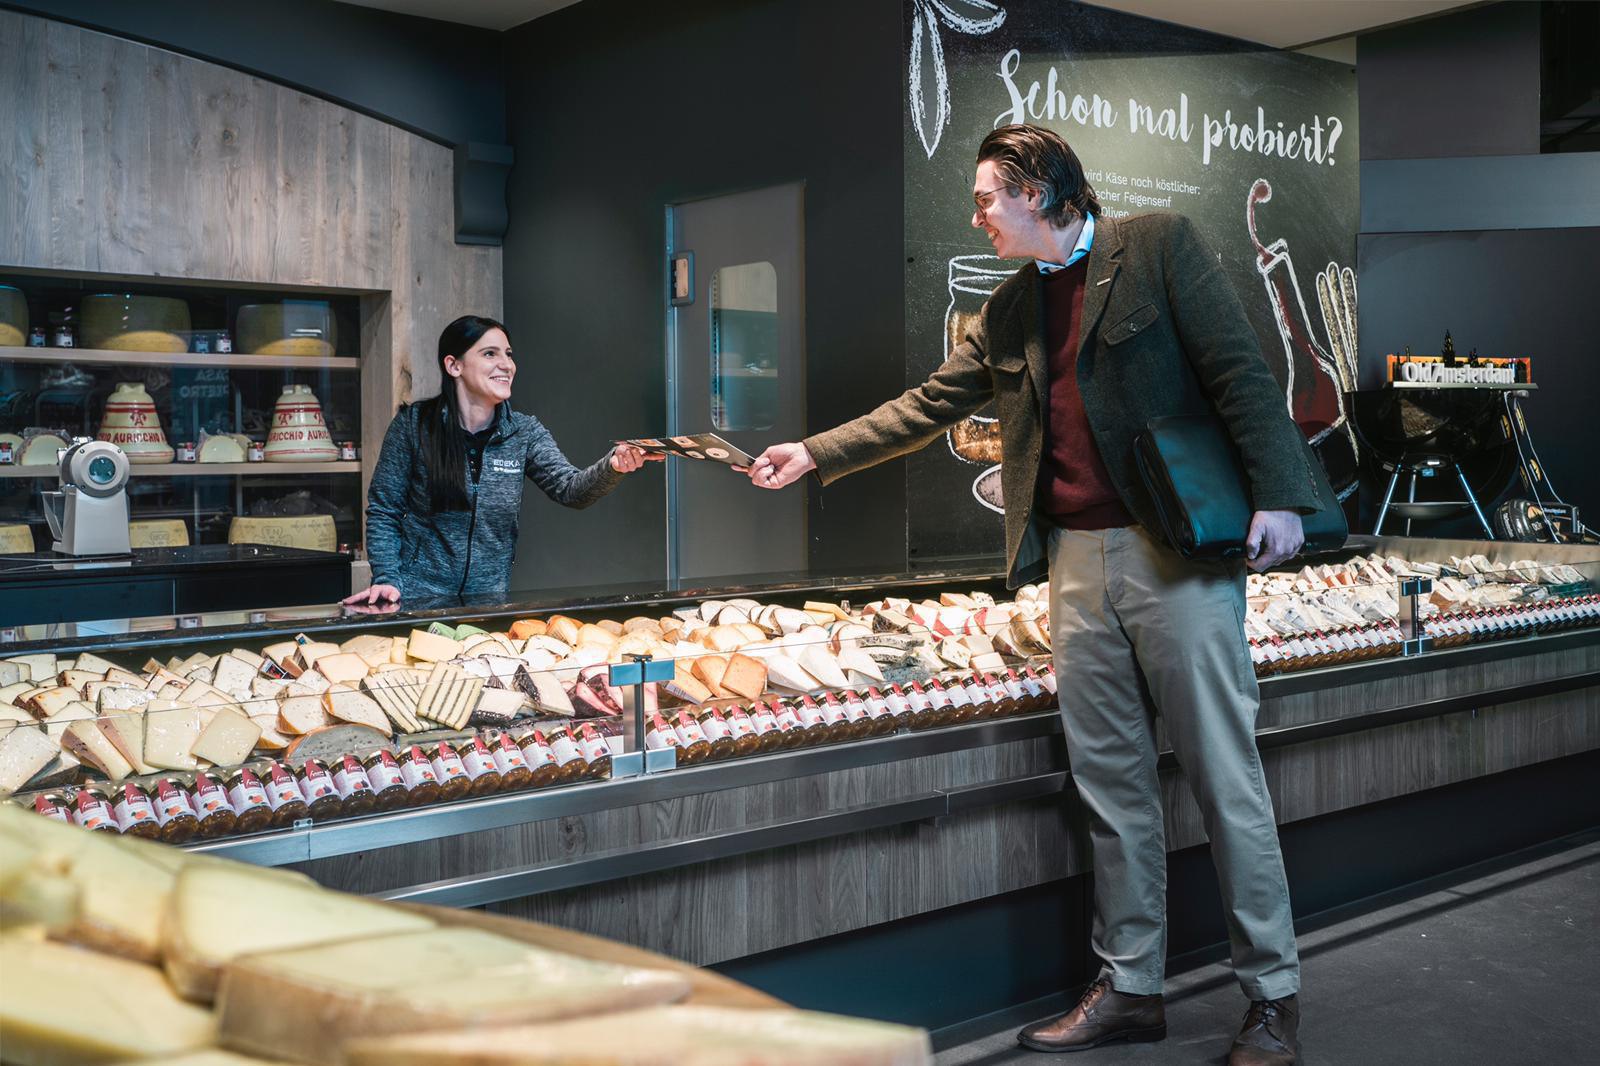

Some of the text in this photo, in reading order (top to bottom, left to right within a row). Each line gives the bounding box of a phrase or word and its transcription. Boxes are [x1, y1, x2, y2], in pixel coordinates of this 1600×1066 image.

[994, 49, 1343, 166] Schon mal probiert?
[1105, 172, 1128, 186] Käse
[1131, 176, 1153, 189] noch
[1155, 178, 1201, 196] köstlicher:
[1093, 188, 1172, 208] scher Feigensenf
